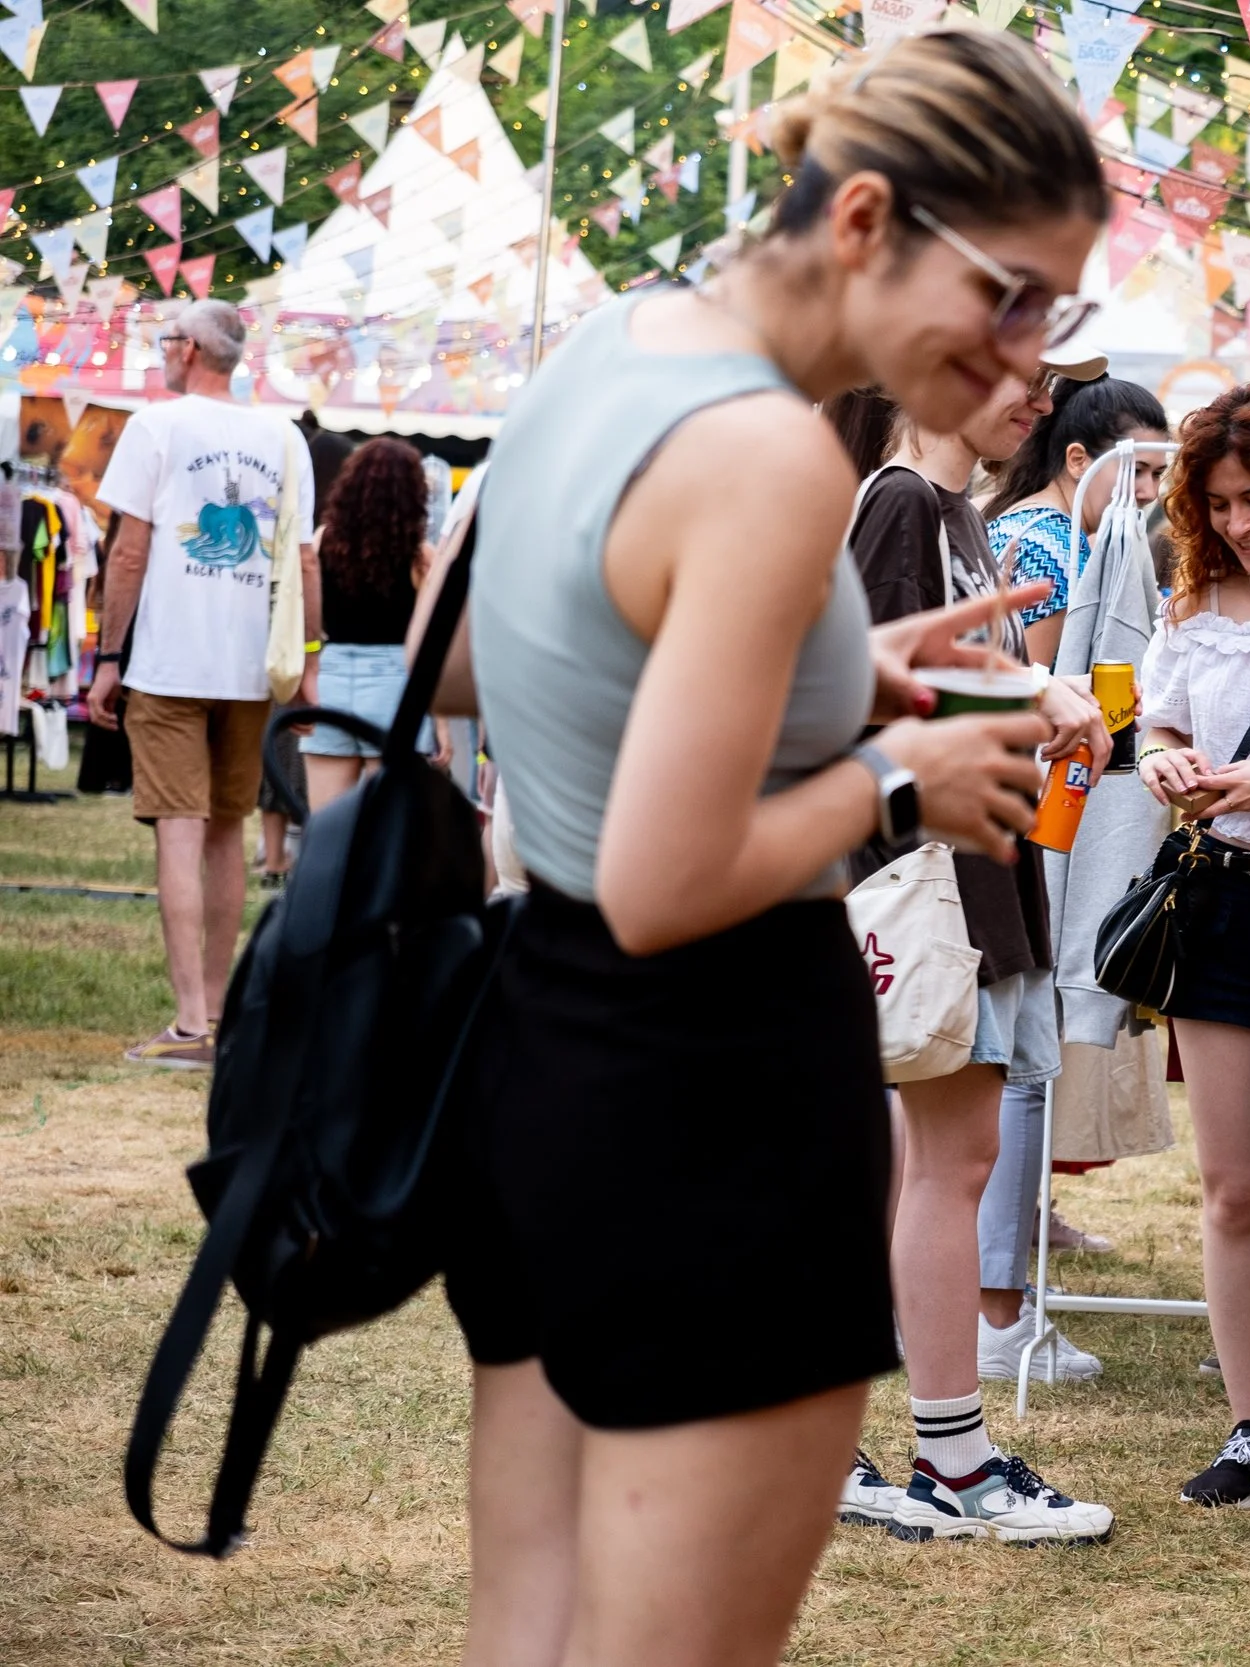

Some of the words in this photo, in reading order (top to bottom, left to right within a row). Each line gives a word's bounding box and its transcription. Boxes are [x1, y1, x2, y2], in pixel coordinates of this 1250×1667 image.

[872, 0, 914, 19] БАЗАР
[1108, 703, 1135, 727] Schw
[1066, 761, 1089, 785] FA
